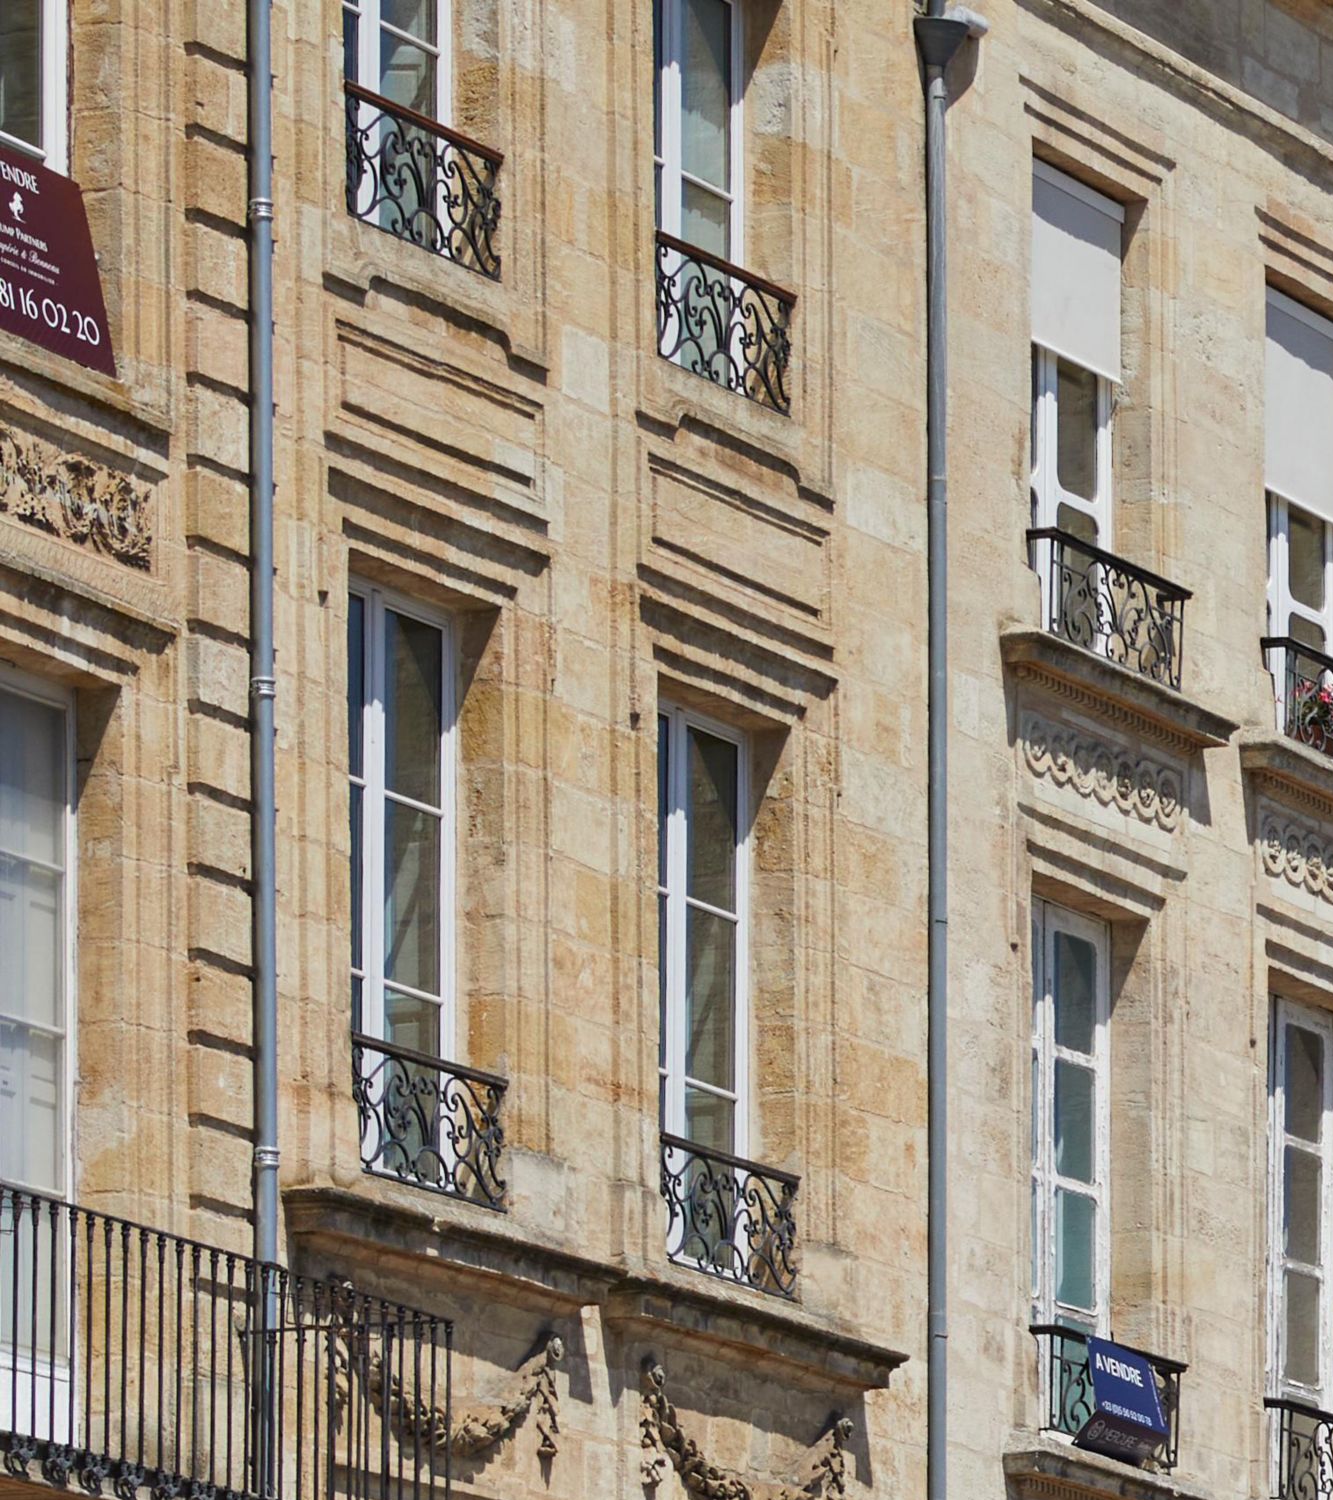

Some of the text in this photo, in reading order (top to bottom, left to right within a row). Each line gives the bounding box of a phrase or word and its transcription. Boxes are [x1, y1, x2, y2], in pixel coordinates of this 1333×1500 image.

[19, 287, 38, 320] 16
[42, 298, 71, 334] 02
[72, 310, 100, 346] 20
[1095, 1352, 1144, 1388] A VENDRE
